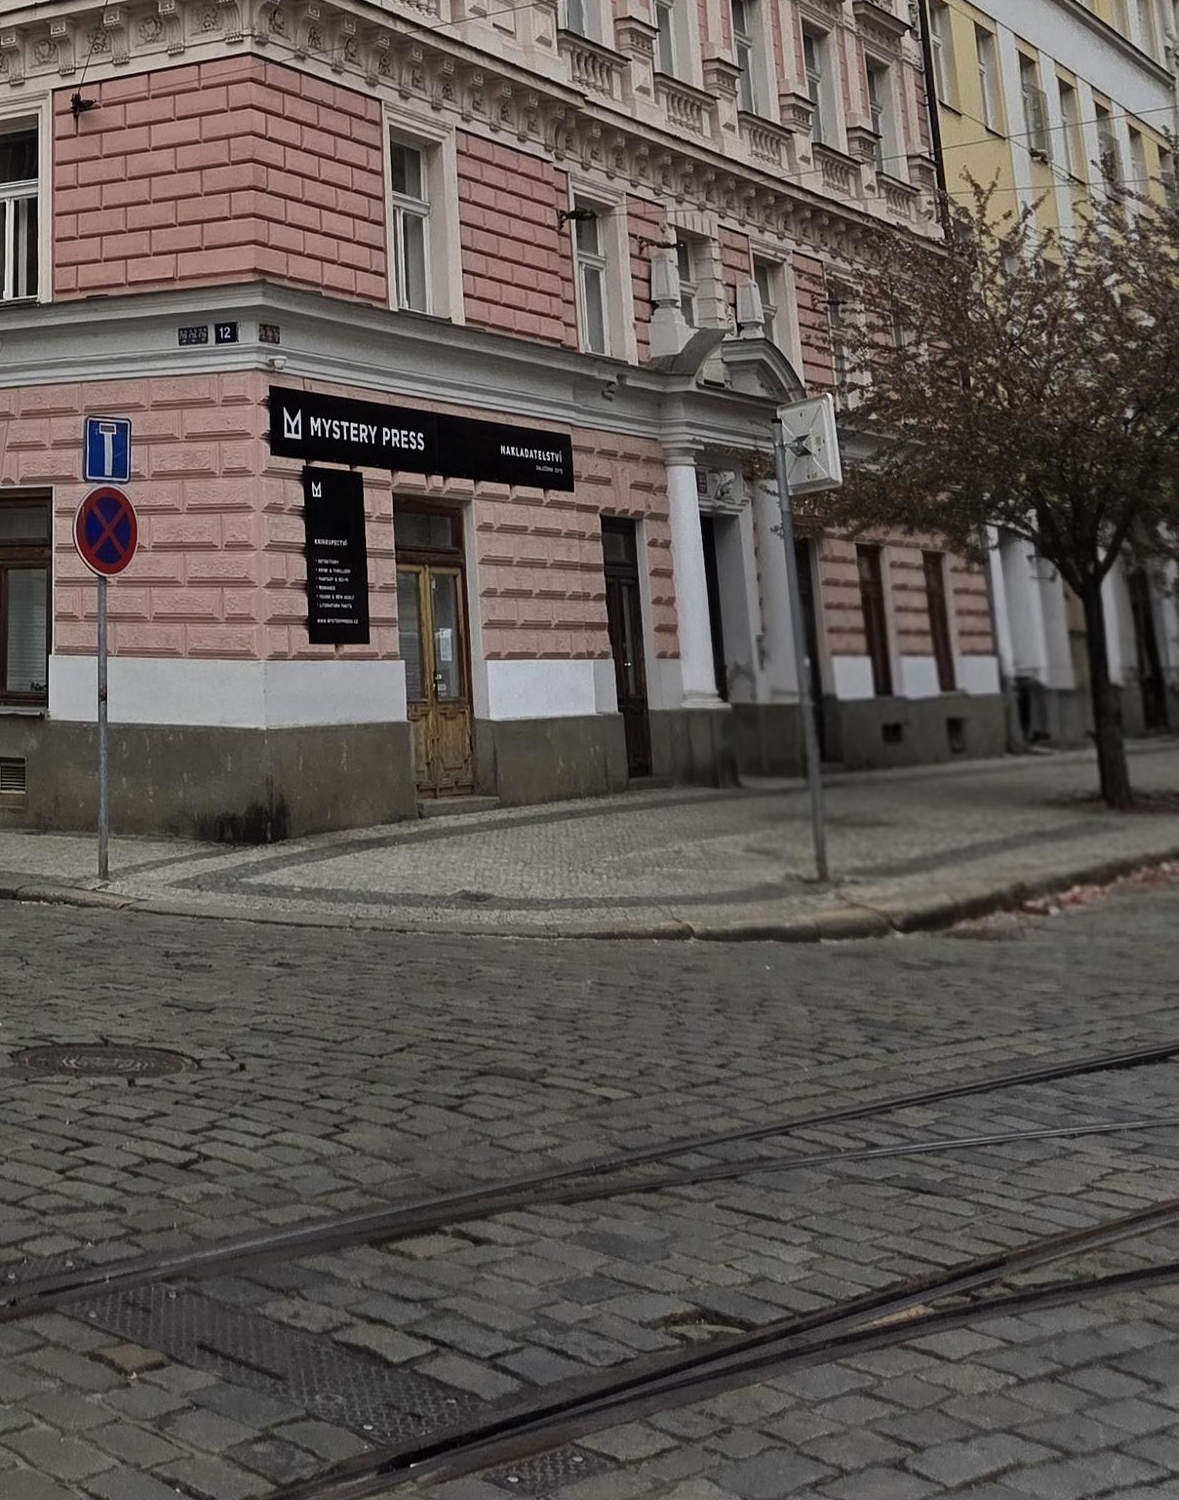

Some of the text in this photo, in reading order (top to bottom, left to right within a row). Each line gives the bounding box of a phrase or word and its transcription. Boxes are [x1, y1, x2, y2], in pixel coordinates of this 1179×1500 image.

[219, 326, 231, 339] 12
[309, 416, 425, 451] MYSTERY PRESS
[500, 444, 563, 463] NAKLADATELSTVÍ
